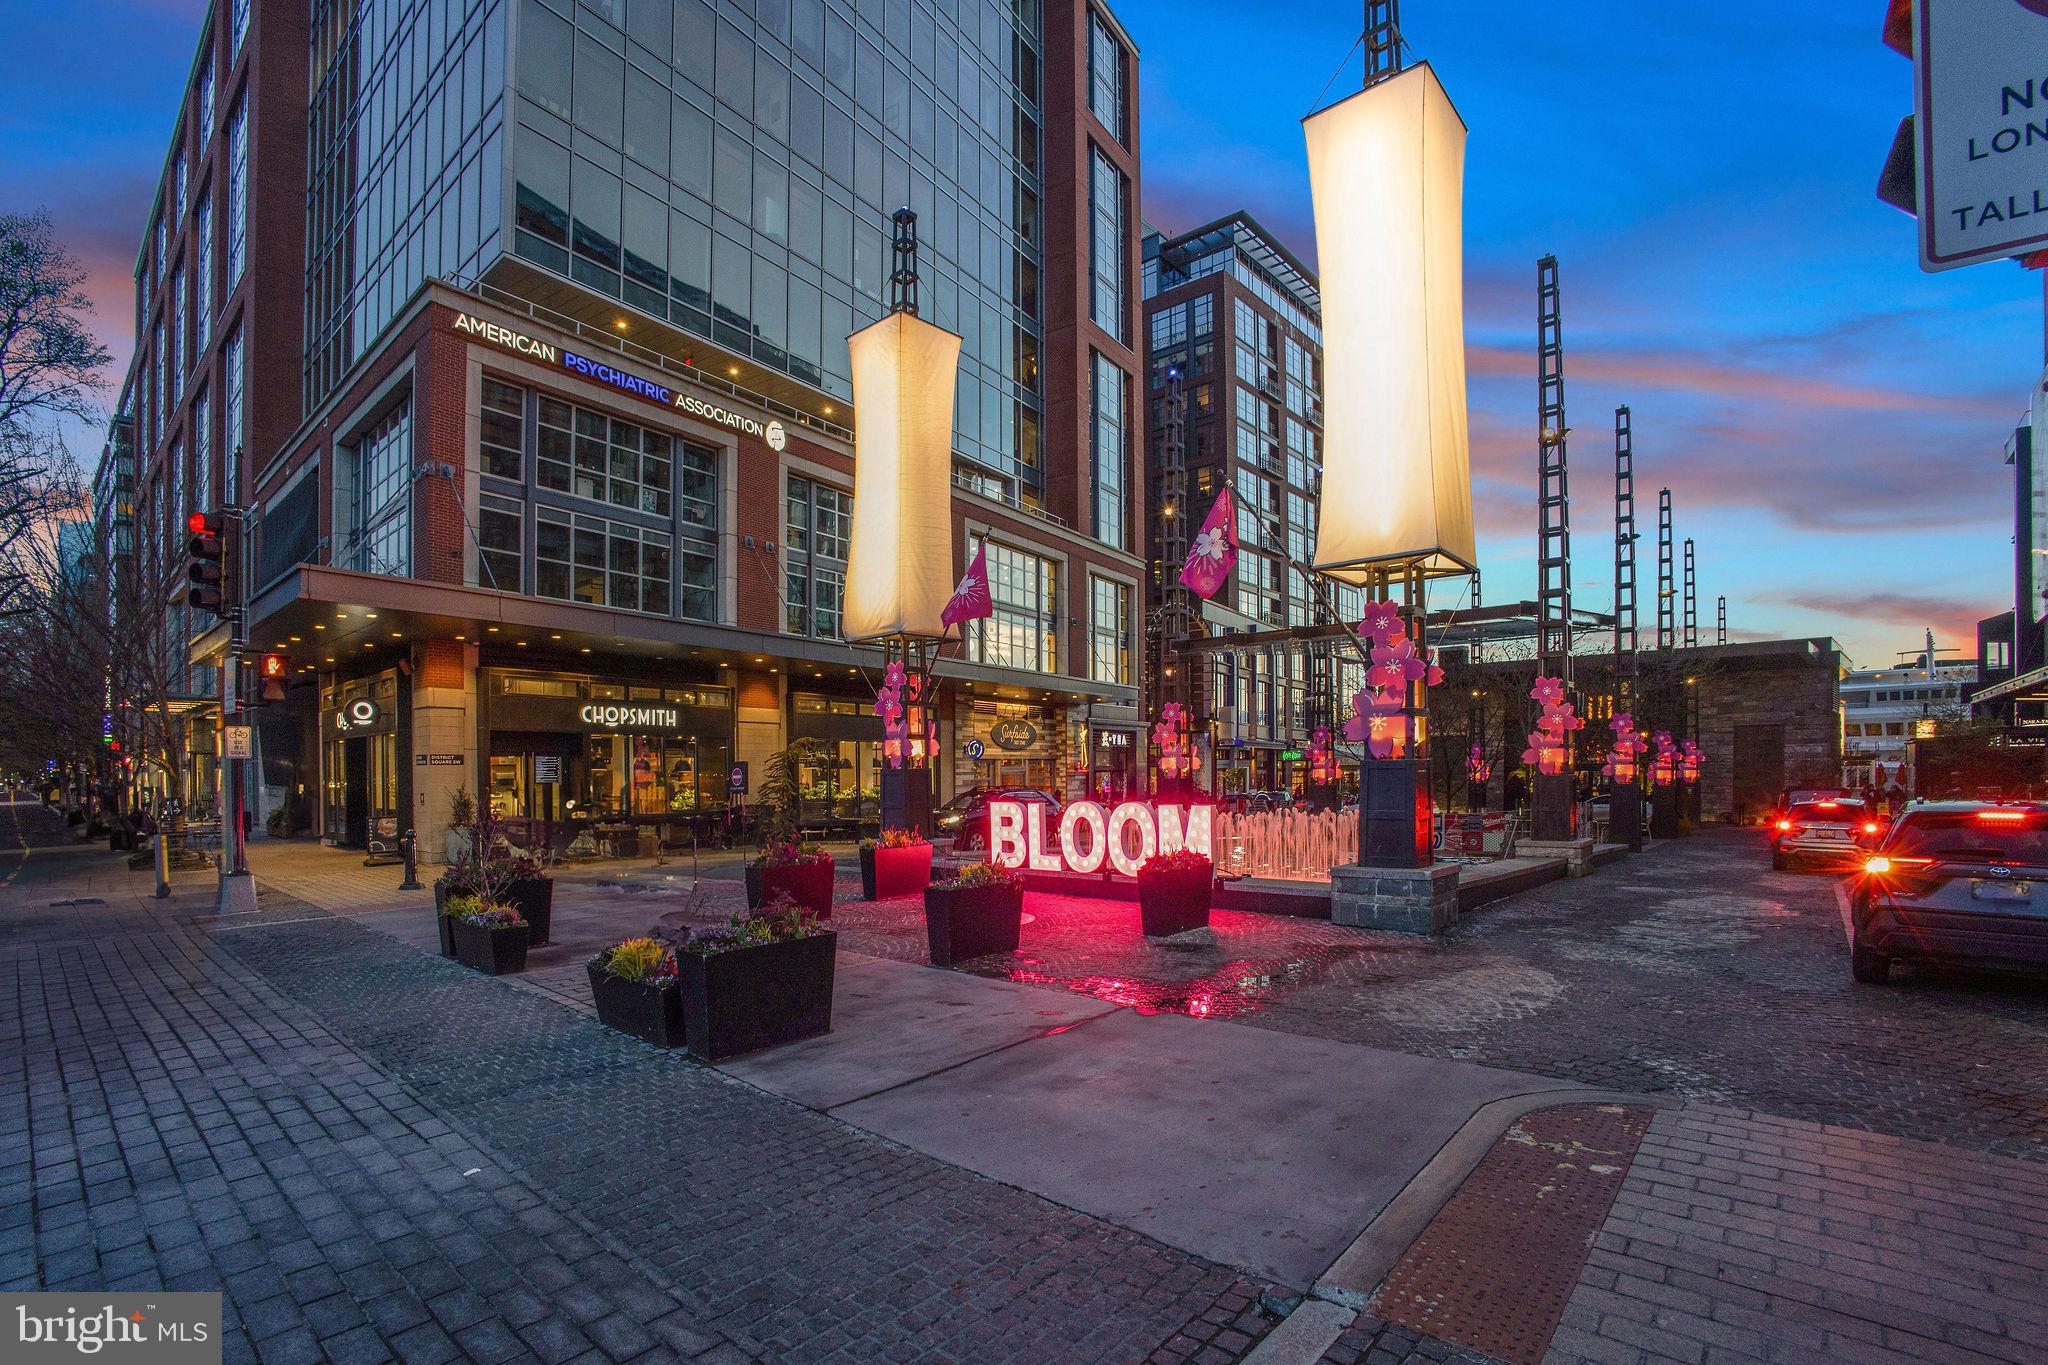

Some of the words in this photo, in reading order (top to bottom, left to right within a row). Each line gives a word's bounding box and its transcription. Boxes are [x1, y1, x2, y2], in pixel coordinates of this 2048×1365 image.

[2001, 77, 2048, 116] N
[454, 313, 555, 363] AMERICAN
[564, 351, 670, 404] PSYCHIATRIC
[675, 393, 763, 438] ASSOCIATION
[581, 705, 676, 727] CHOPSMITH
[1000, 723, 1030, 743] Surfside
[990, 800, 1216, 876] BLOOM
